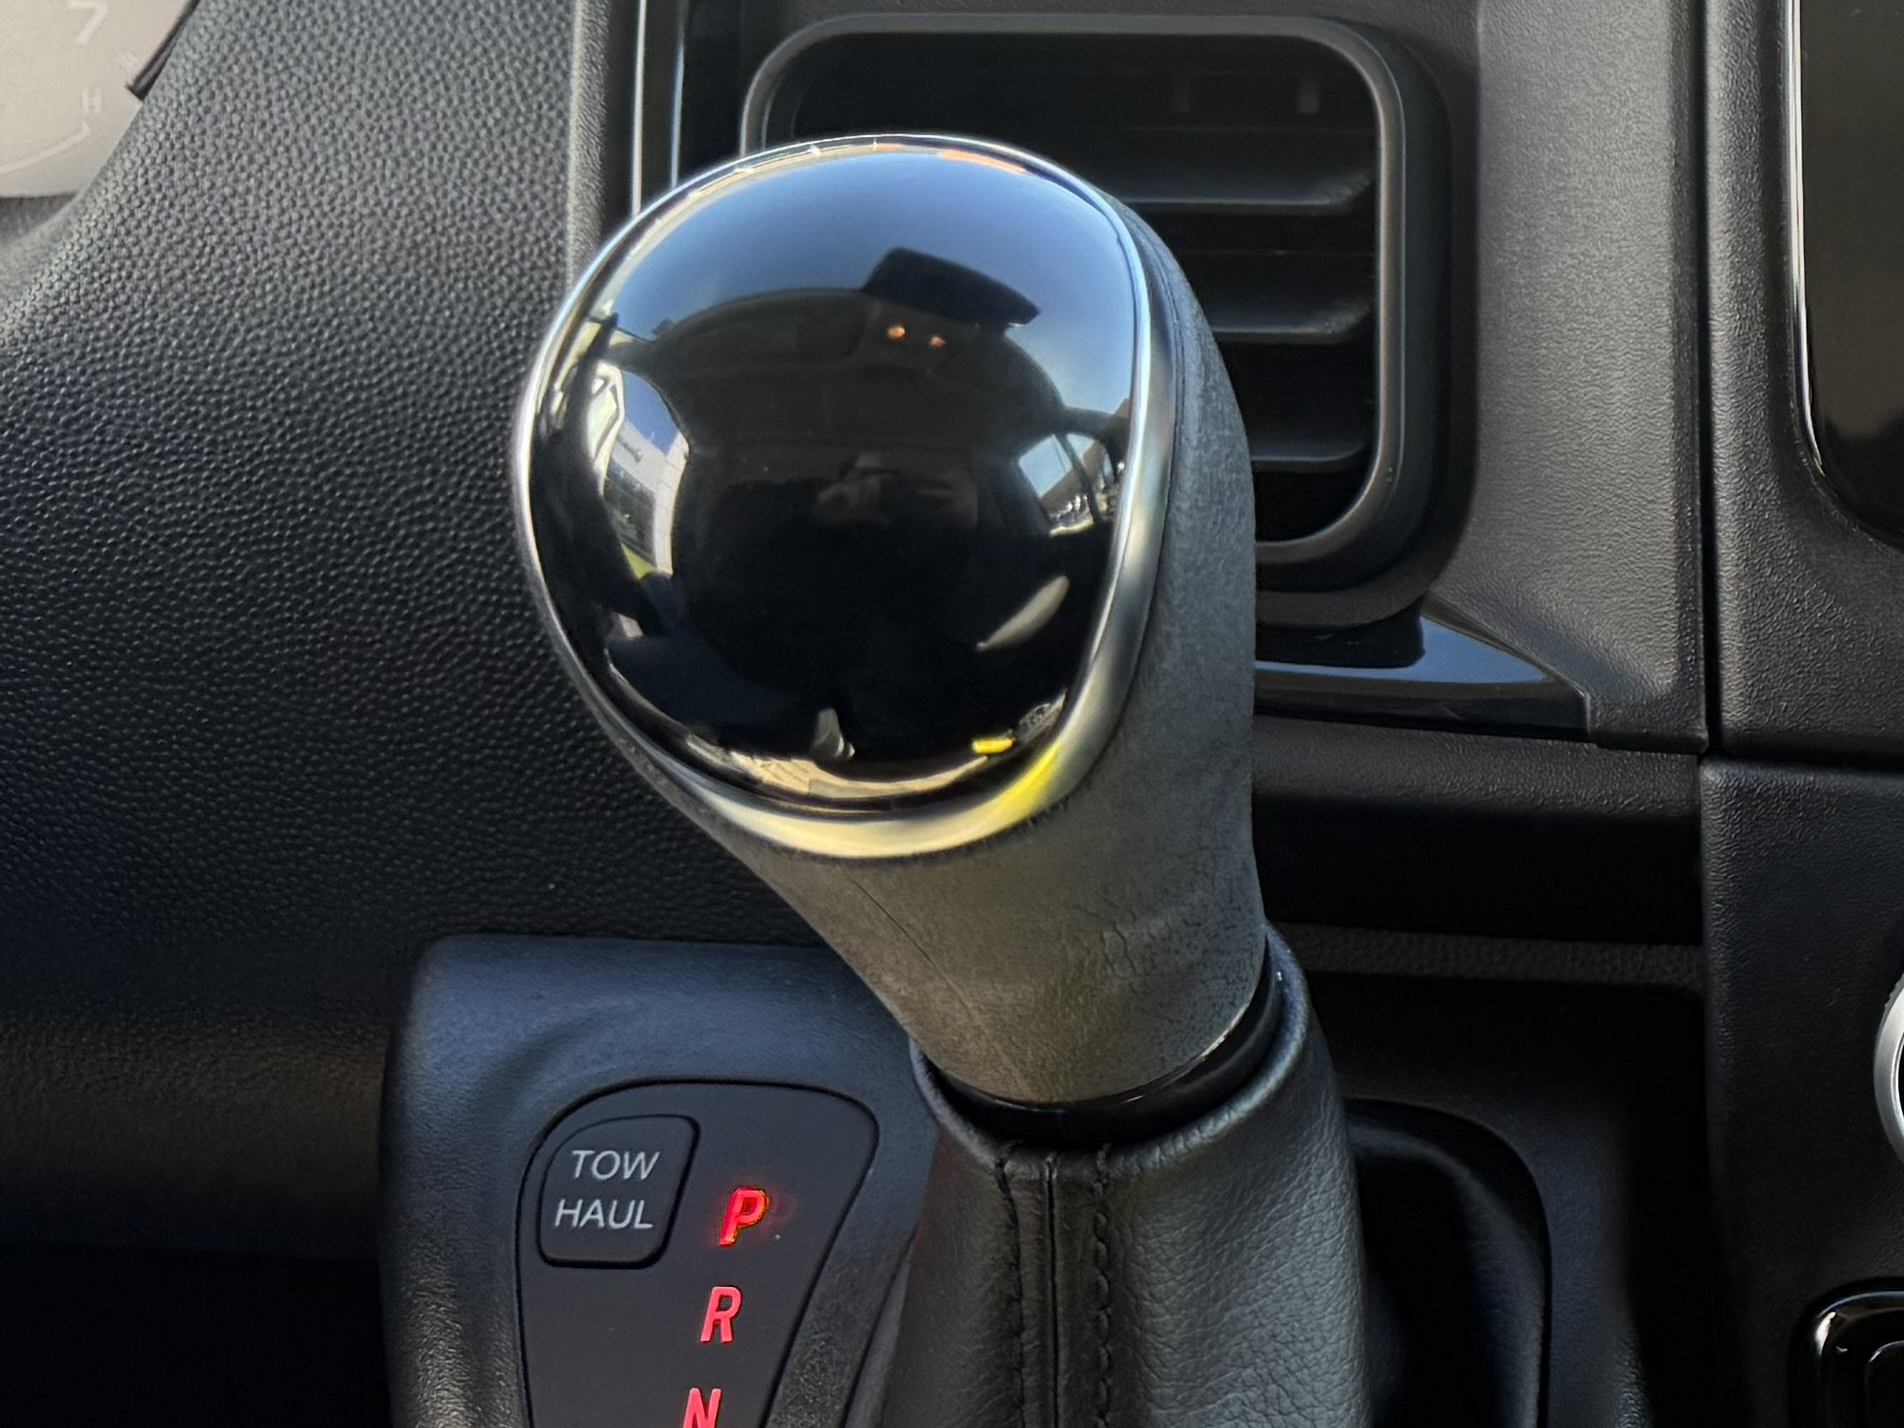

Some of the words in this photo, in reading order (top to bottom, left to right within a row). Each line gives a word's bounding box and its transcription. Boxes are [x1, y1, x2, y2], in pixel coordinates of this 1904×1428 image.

[67, 0, 109, 46] 7
[572, 1151, 660, 1180] TOW
[554, 1199, 654, 1229] HAUL
[719, 1187, 768, 1246] P
[700, 1286, 742, 1343] R
